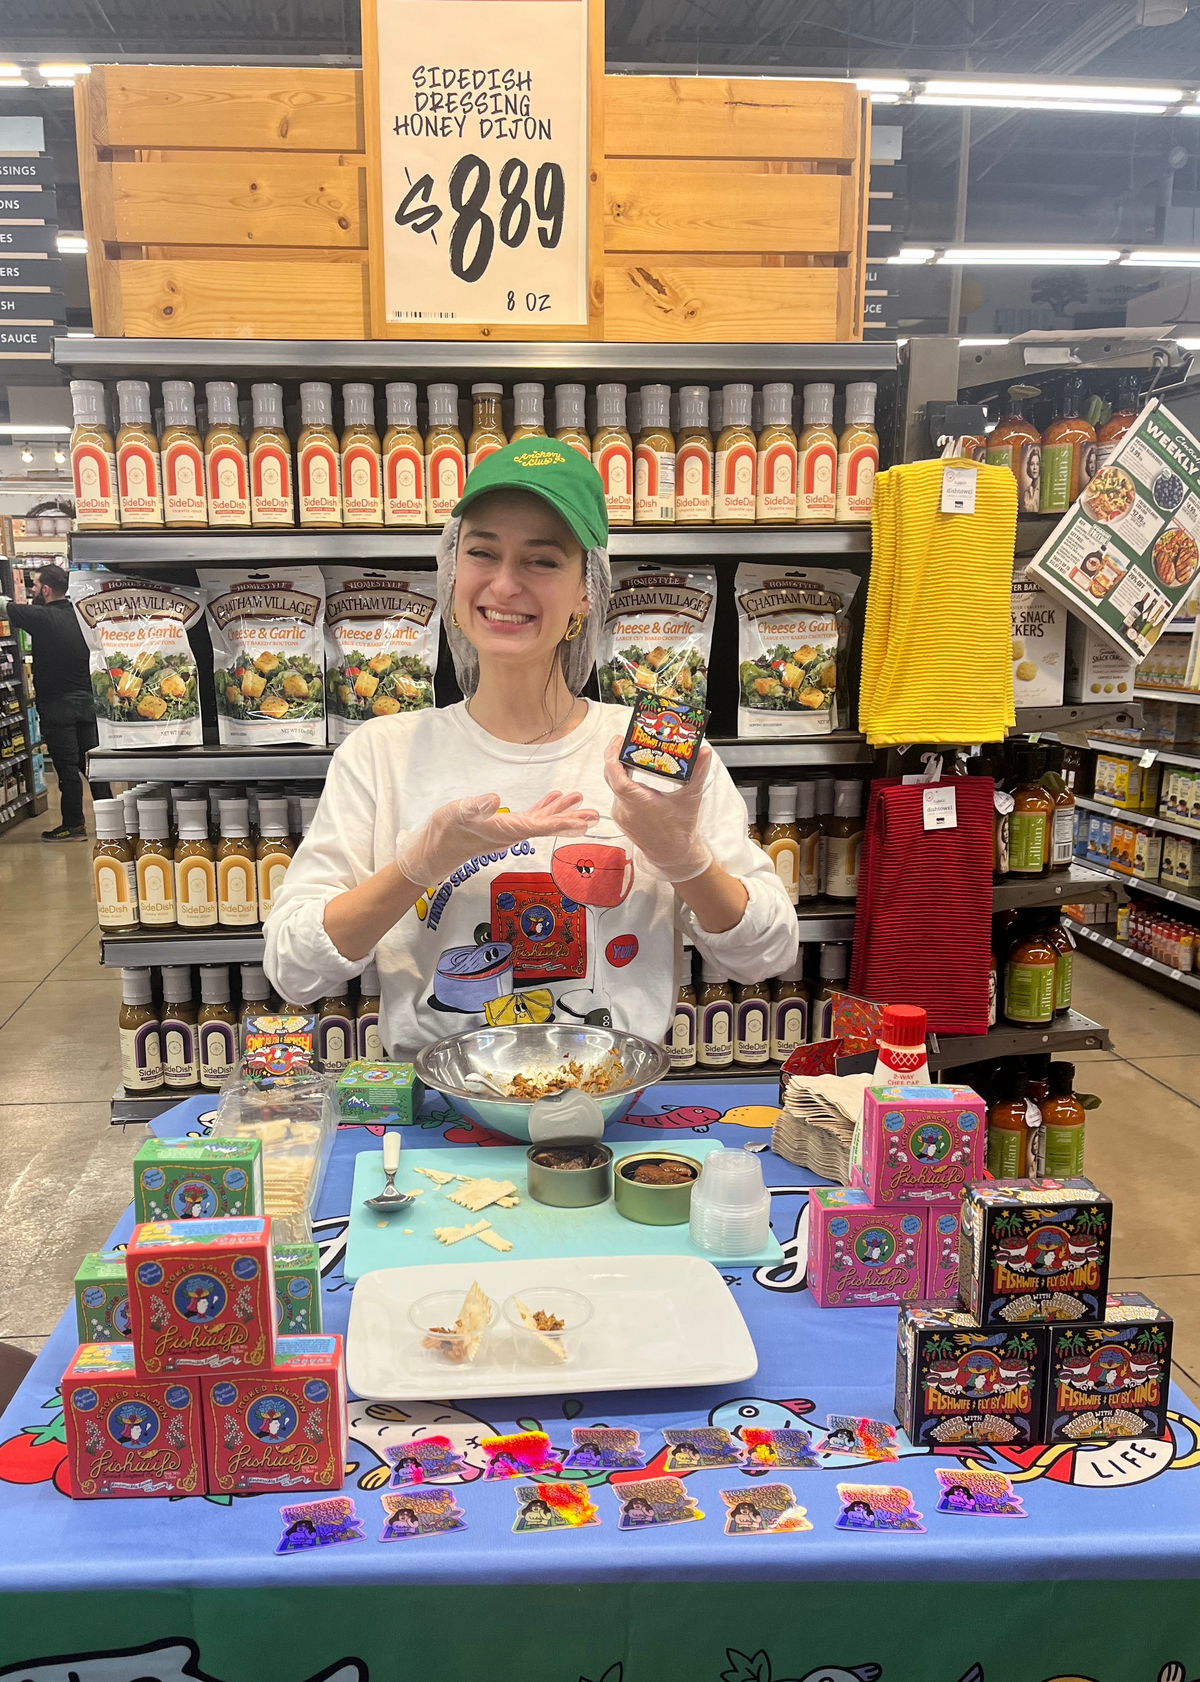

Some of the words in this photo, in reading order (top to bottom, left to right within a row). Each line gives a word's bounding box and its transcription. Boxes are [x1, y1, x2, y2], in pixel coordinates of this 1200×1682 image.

[412, 67, 532, 90] SIDEDISH
[415, 92, 531, 117] DRESSING
[393, 115, 466, 138] HONEY
[480, 117, 552, 140] DIJON
[506, 289, 516, 312] 8
[526, 293, 551, 311] OZ
[1, 334, 37, 342] SAUCE
[1146, 420, 1199, 476] WEEKLY
[1053, 450, 1069, 506] Lillian's
[122, 498, 156, 507] SideDish
[169, 499, 204, 508] SideDish
[213, 500, 246, 510] SideDish
[255, 498, 289, 508] SideDish
[304, 498, 337, 507] SideDish
[345, 499, 378, 508] SideDish
[390, 500, 422, 509] SideDish
[676, 498, 709, 507] SideDish
[1135, 579, 1145, 589] OFF
[85, 596, 142, 617] CHATHAM
[142, 597, 190, 615] VILLAGE
[264, 597, 313, 616] VILLAGE
[327, 598, 380, 617] CHATHAM
[382, 597, 427, 617] VILLAGE
[658, 593, 704, 611] VILLAGE
[746, 597, 798, 612] CHATHAM
[1020, 610, 1055, 624] SNACK
[137, 629, 145, 639] &
[259, 628, 266, 638] &
[269, 626, 306, 639] Garlic
[334, 626, 374, 640] Cheese
[376, 628, 382, 638] &
[612, 621, 650, 635] Cheese
[653, 623, 660, 633] &
[663, 622, 695, 635] Garlic
[758, 621, 796, 634] Cheese
[798, 622, 807, 632] &
[633, 726, 658, 747] FISHWIFE
[675, 741, 693, 758] JING
[1029, 818, 1043, 866] Lillian's
[141, 902, 173, 911] SideDish
[182, 905, 215, 913] SideDish
[221, 904, 254, 912] SideDish
[427, 883, 453, 931] TINNED
[510, 942, 570, 966] Fishwife
[1040, 969, 1053, 1018] Lillian's
[738, 1041, 768, 1050] SideDish
[918, 1115, 953, 1128] ALBACORE
[890, 1164, 965, 1190] Fishwife
[161, 1264, 195, 1296] SMOKED
[200, 1263, 236, 1292] SALMON
[836, 1267, 910, 1291] Fishwife
[997, 1265, 1039, 1288] FISHWIFE
[1047, 1277, 1059, 1287] FLY
[1060, 1272, 1070, 1286] BY
[1070, 1261, 1097, 1286] JING
[999, 1294, 1032, 1317] SMOKED
[1053, 1292, 1088, 1312] SICHUAN
[155, 1322, 249, 1356] Fishwife
[235, 1385, 268, 1416] SMOKED
[273, 1385, 307, 1413] SALMON
[928, 1386, 970, 1410] FISHWIFE
[978, 1398, 990, 1409] FLY
[991, 1395, 1001, 1408] BY
[1001, 1385, 1028, 1409] JING
[1061, 1385, 1101, 1407] FISHWIFE
[1108, 1394, 1120, 1405] FLY
[1121, 1392, 1130, 1404] BY
[1130, 1379, 1158, 1403] JING
[96, 1391, 128, 1420] SMOKED
[134, 1391, 169, 1420] SALMON
[931, 1416, 963, 1436] SMOKED
[984, 1414, 1020, 1436] SICHUAN
[1062, 1412, 1094, 1434] SMOKED
[1114, 1409, 1148, 1429] SICHUAN
[90, 1448, 181, 1479] Fishwife
[228, 1443, 318, 1474] Fishwife
[1091, 1442, 1157, 1478] LIFE
[966, 1472, 999, 1480] GIRLS
[311, 1500, 344, 1510] GIRLS
